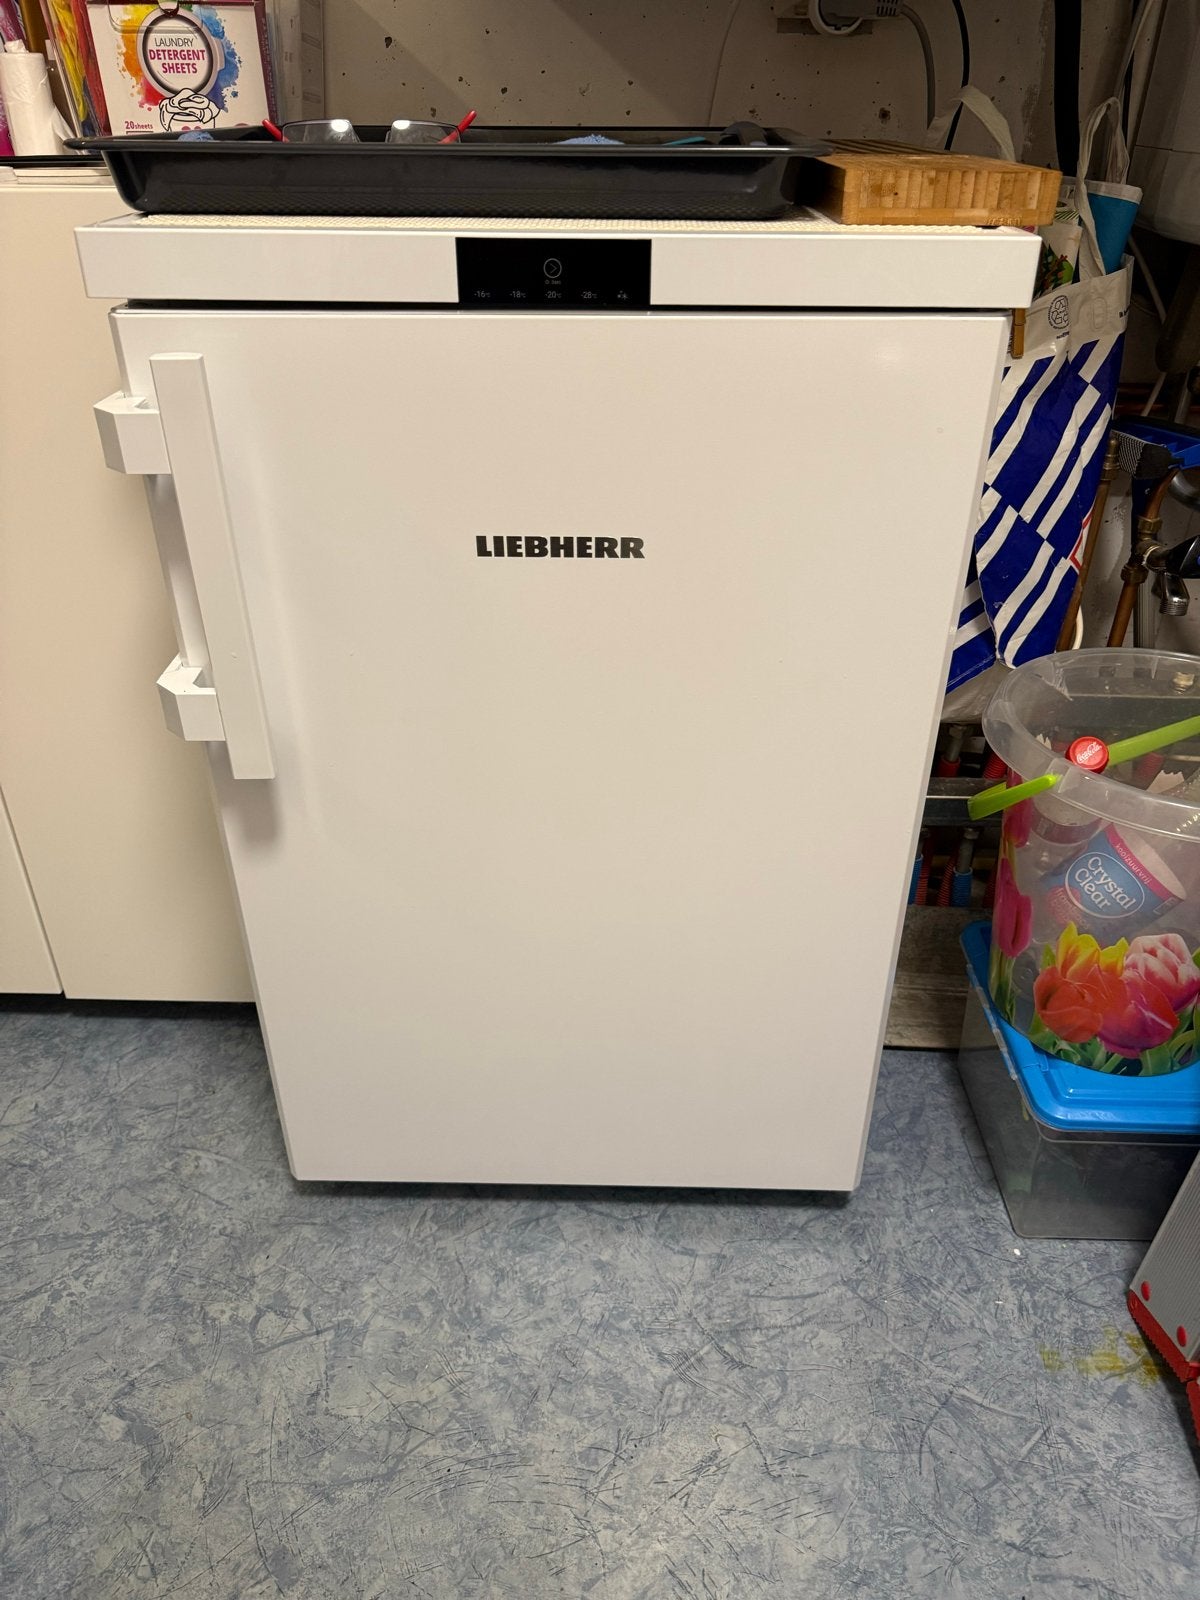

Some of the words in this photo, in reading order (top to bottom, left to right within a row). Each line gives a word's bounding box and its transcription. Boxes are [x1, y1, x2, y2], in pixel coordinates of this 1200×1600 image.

[154, 37, 194, 48] LAUNDRY
[149, 49, 206, 62] DETERGENT
[161, 62, 198, 75] SHEETS
[476, 535, 646, 559] LIEBHERR
[1115, 843, 1152, 885] koolzuurvrij
[1074, 868, 1111, 909] Clear
[1087, 856, 1136, 909] Crystal
